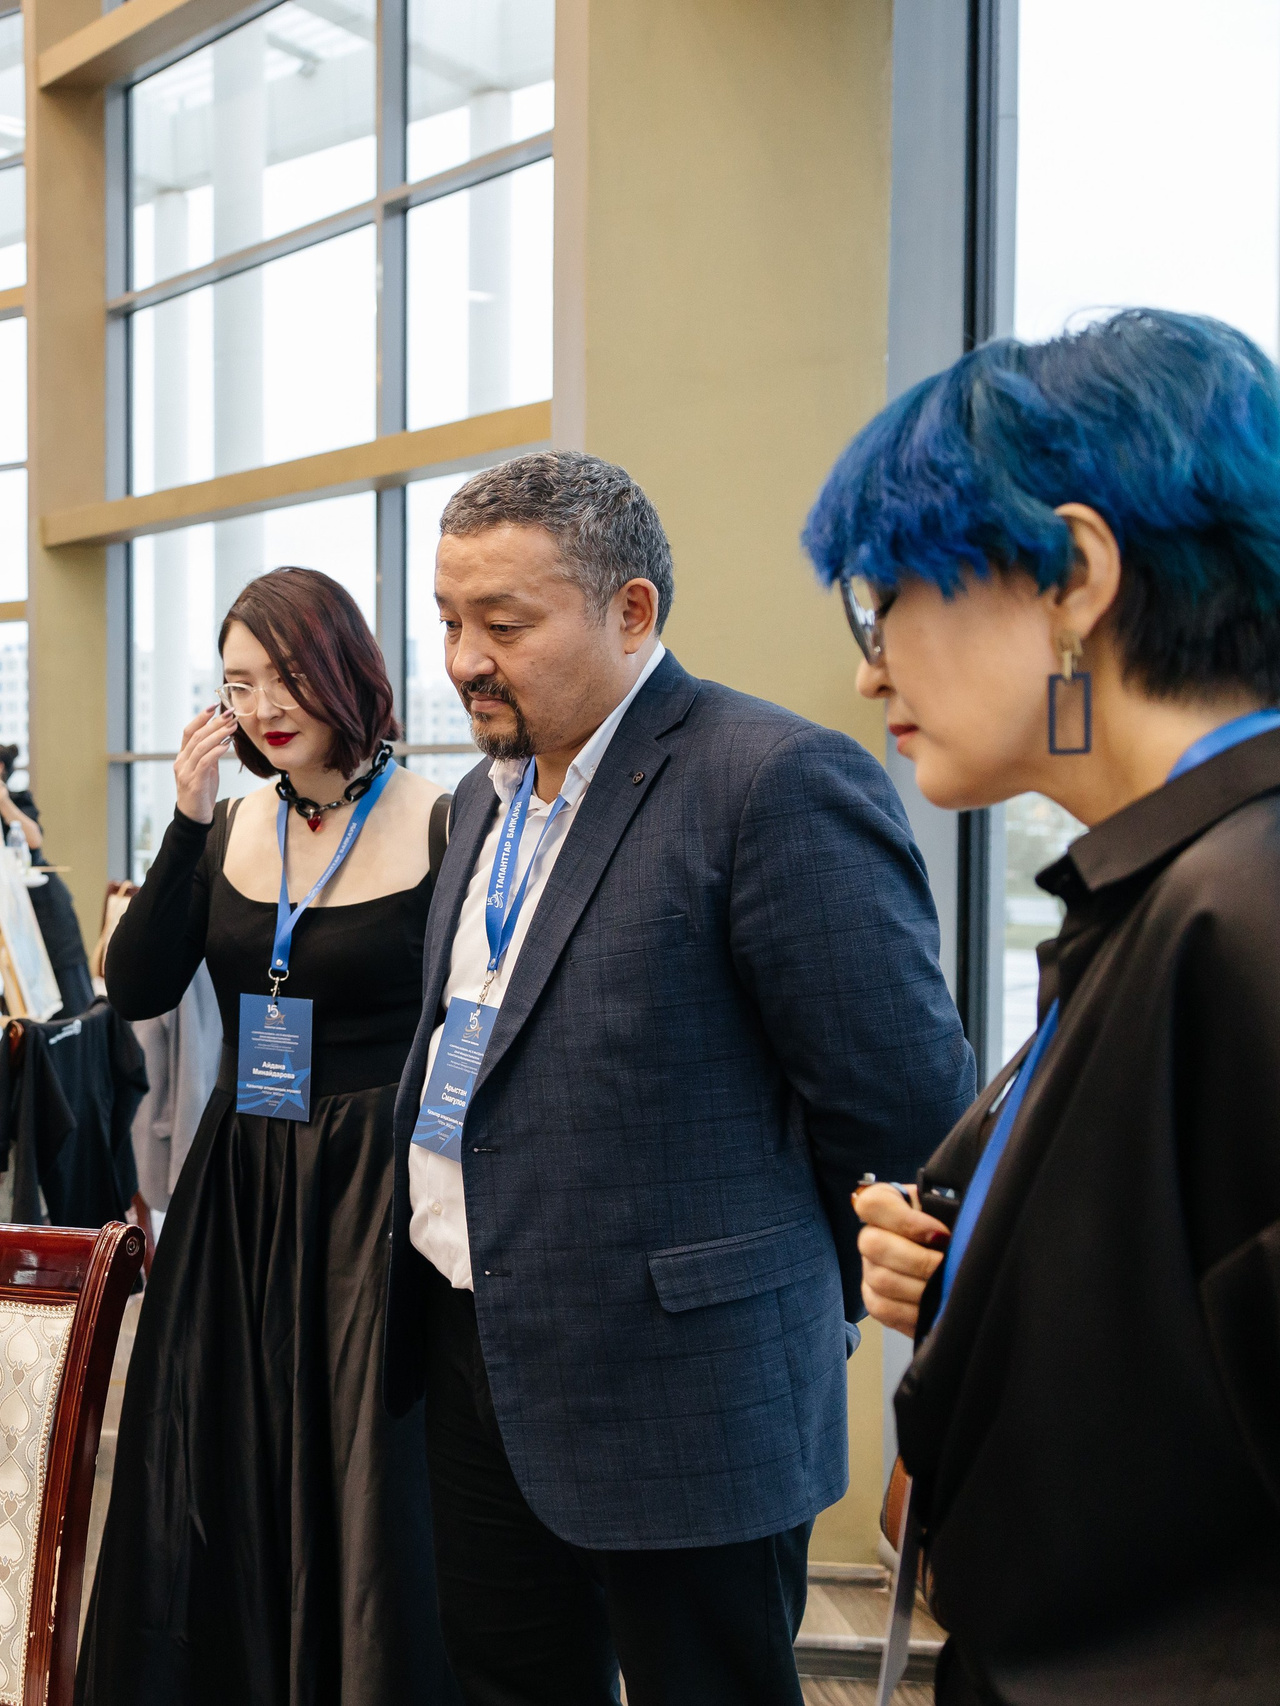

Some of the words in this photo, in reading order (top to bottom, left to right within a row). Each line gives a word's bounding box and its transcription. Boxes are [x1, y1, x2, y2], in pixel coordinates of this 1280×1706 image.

[267, 1004, 279, 1018] 15
[469, 1012, 478, 1029] 15
[444, 1082, 468, 1097] Арыстан
